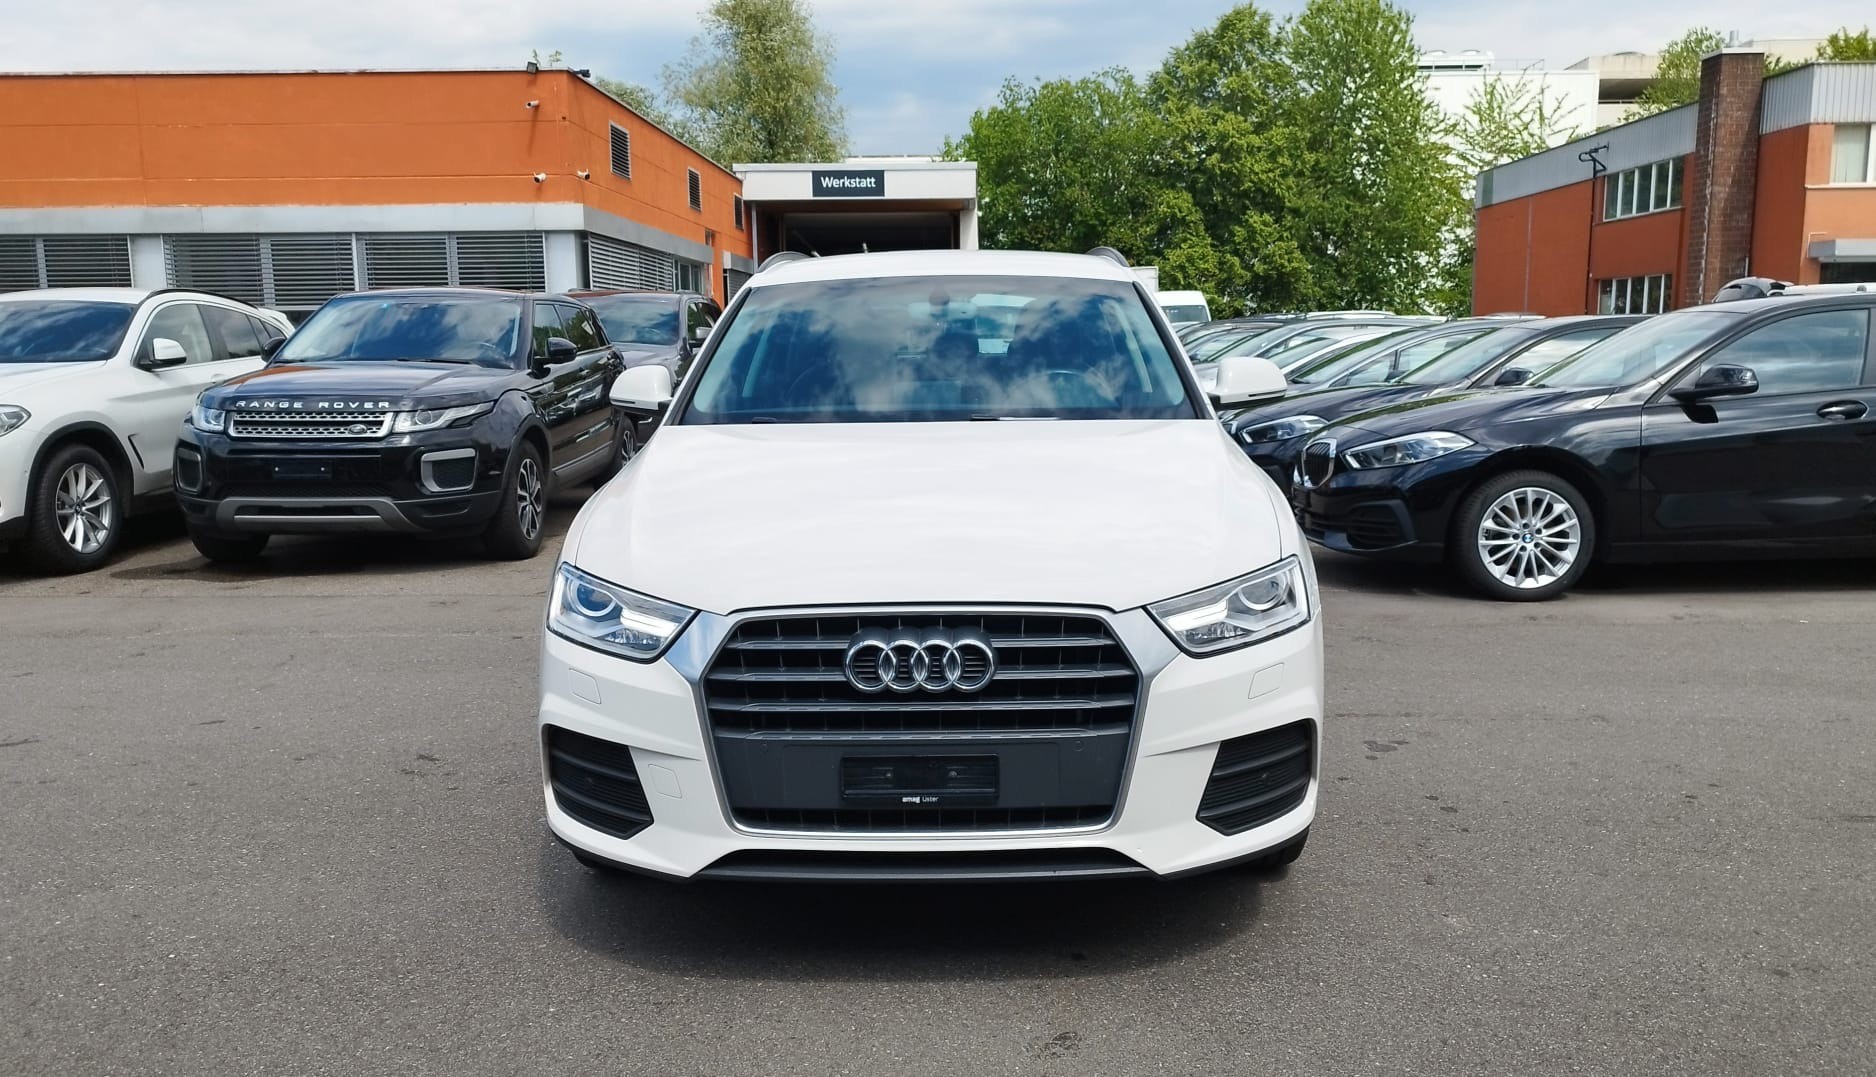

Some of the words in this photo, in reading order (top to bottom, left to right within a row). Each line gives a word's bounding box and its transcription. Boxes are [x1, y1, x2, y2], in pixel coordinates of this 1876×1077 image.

[820, 175, 876, 188] Werkstatt
[235, 400, 304, 409] RANGE
[318, 401, 390, 409] ROVER
